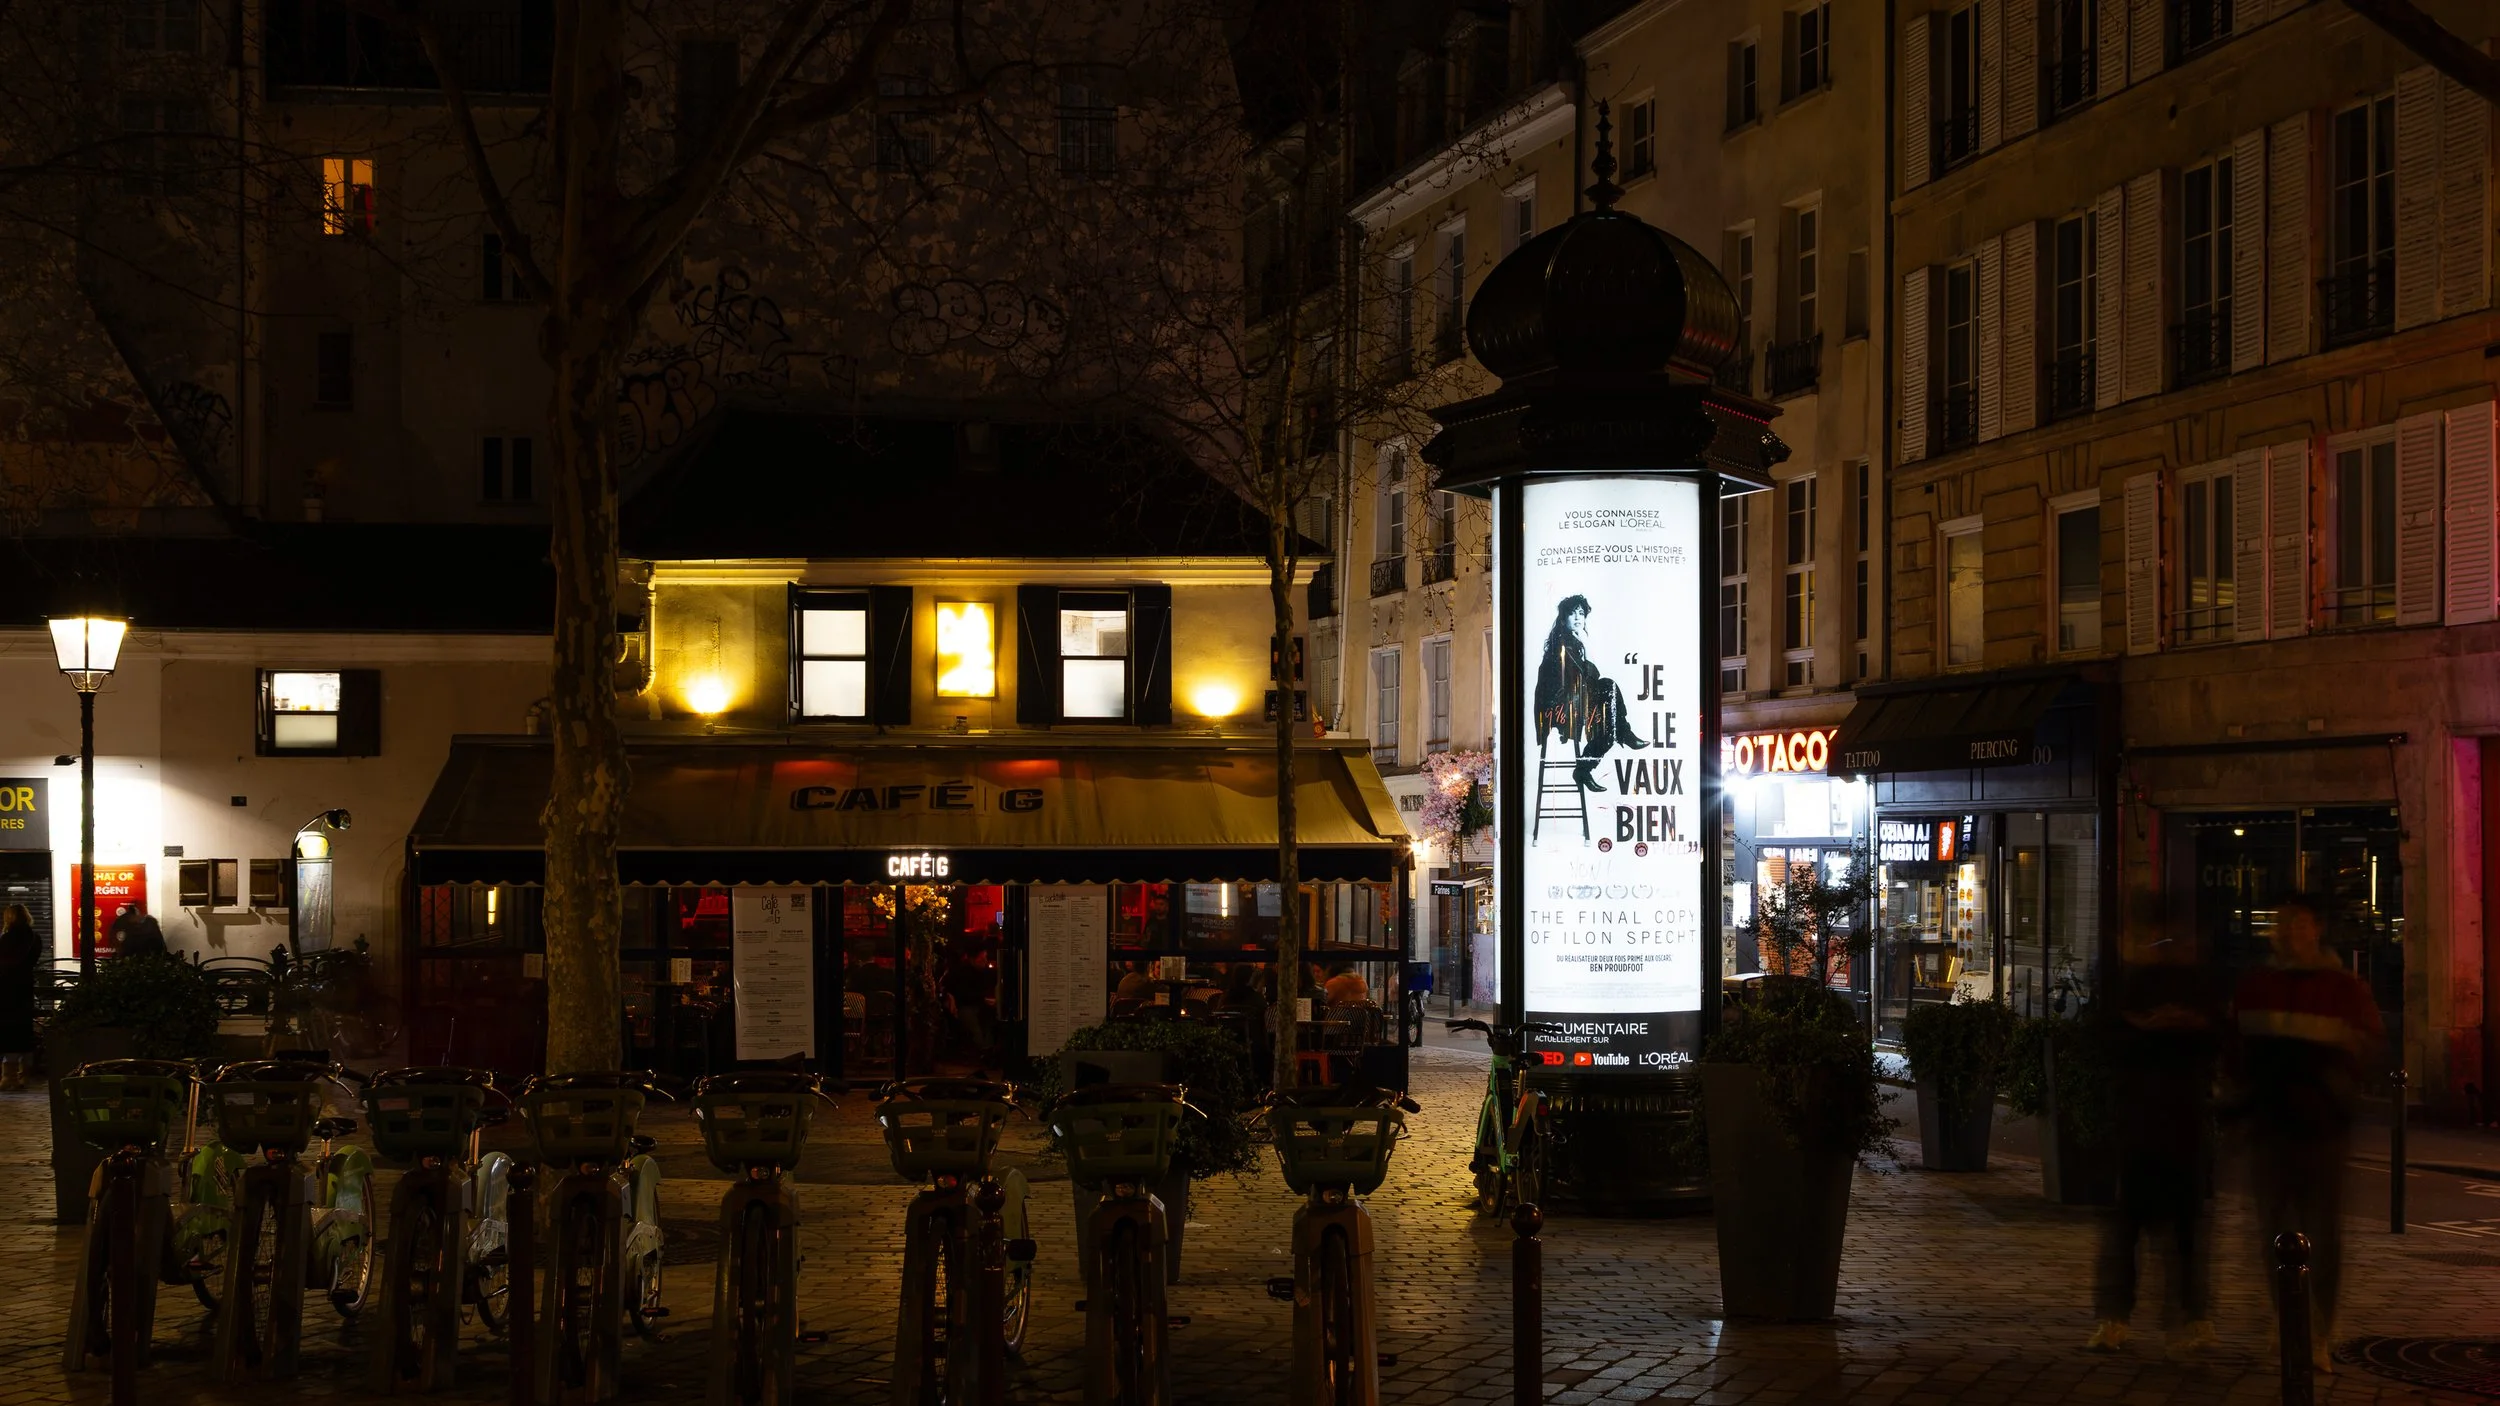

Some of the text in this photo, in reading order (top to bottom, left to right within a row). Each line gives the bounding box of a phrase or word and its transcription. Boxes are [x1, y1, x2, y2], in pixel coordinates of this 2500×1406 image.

[1565, 509, 1660, 519] VOUS CONNAISSEZ
[1559, 520, 1570, 530] LE
[1573, 519, 1615, 529] SLOGAN
[1540, 544, 1683, 557] CONNAISSEZ-VOUS L'HISTOIRE
[1537, 558, 1549, 567] DE
[1551, 557, 1563, 566] LA
[1565, 555, 1601, 564] FEMME
[1603, 554, 1622, 563] QUI
[1625, 554, 1640, 563] L'A
[1653, 712, 1677, 748] LE
[1734, 729, 1838, 775] O'TACO
[1845, 738, 2018, 768] TATTOO PIERCING
[1615, 759, 1684, 796] VAUX
[0, 786, 36, 812] OR
[94, 872, 135, 881] HAT OR
[1530, 909, 1697, 925] THE FINAL COPY
[1530, 929, 1697, 945] OF ILON SPECHT
[1556, 954, 1565, 962] DU
[1598, 954, 1614, 963] DEUX
[1614, 954, 1627, 963] FOIS
[1644, 954, 1655, 962] AUX
[1589, 963, 1644, 972] BEN PROUDFOOT
[1535, 1022, 1649, 1035] CUMENTAIRE
[1534, 1034, 1610, 1044] ACTUELLEMENT SUR
[1541, 1051, 1565, 1066] ED
[1592, 1053, 1630, 1066] YouTube
[1638, 1051, 1693, 1066] L'ORÉAL
